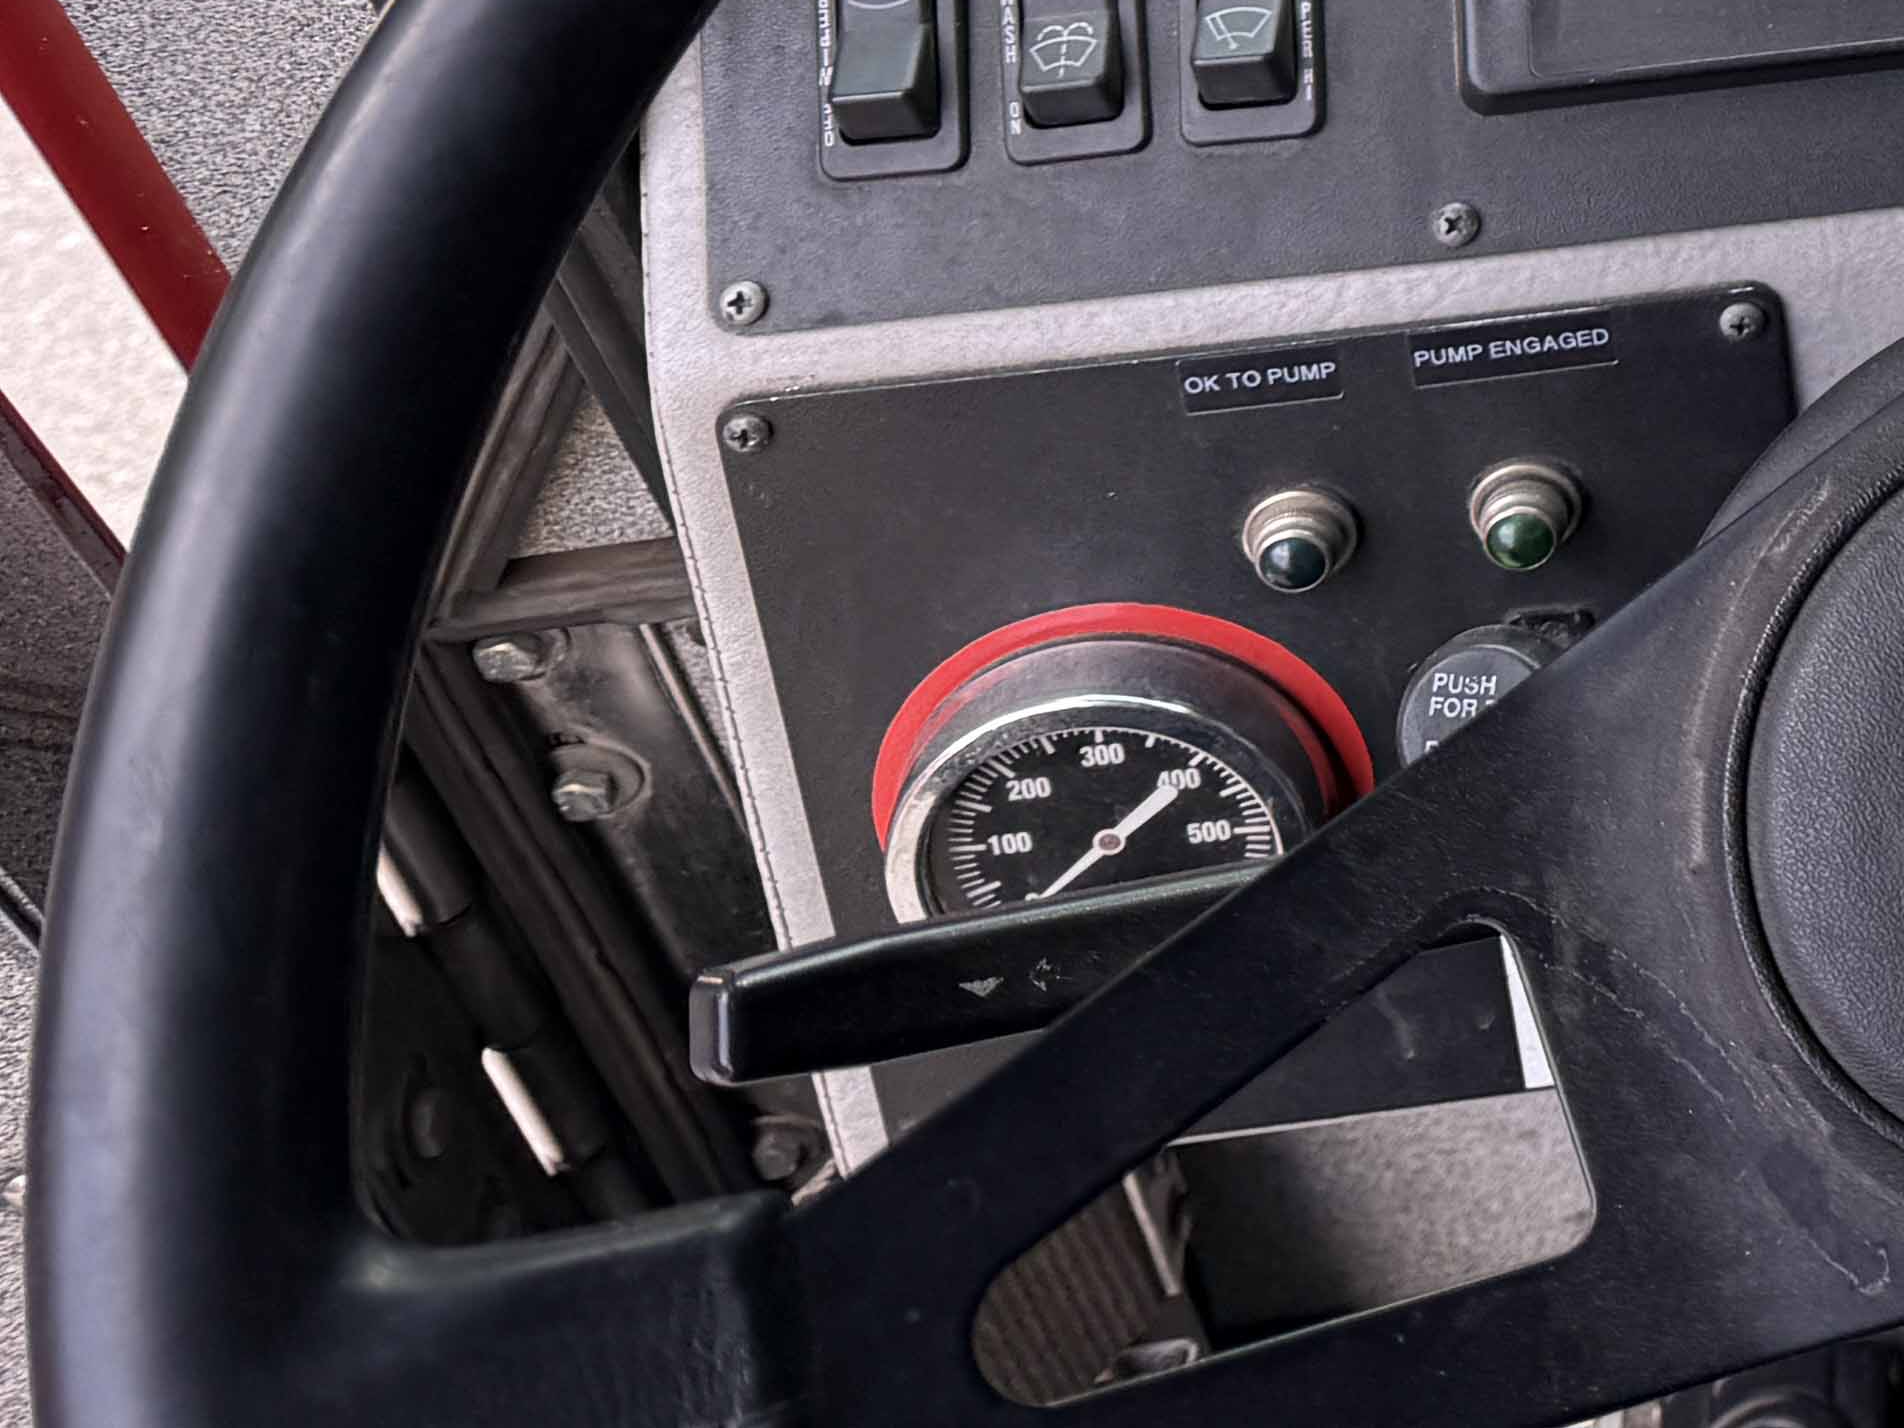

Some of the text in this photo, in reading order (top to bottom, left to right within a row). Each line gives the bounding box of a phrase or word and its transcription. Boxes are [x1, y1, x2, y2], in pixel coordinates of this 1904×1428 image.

[1009, 101, 1022, 136] ON
[1413, 327, 1611, 368] PUMP ENGAGED
[1184, 361, 1337, 395] OK TO PUMP
[1431, 673, 1498, 696] PUSH
[1428, 696, 1479, 718] FOR
[1078, 743, 1126, 768] 300
[1005, 776, 1051, 802] 200
[1156, 767, 1202, 792] 400
[985, 831, 1033, 856] 100
[1185, 819, 1232, 845] 500
